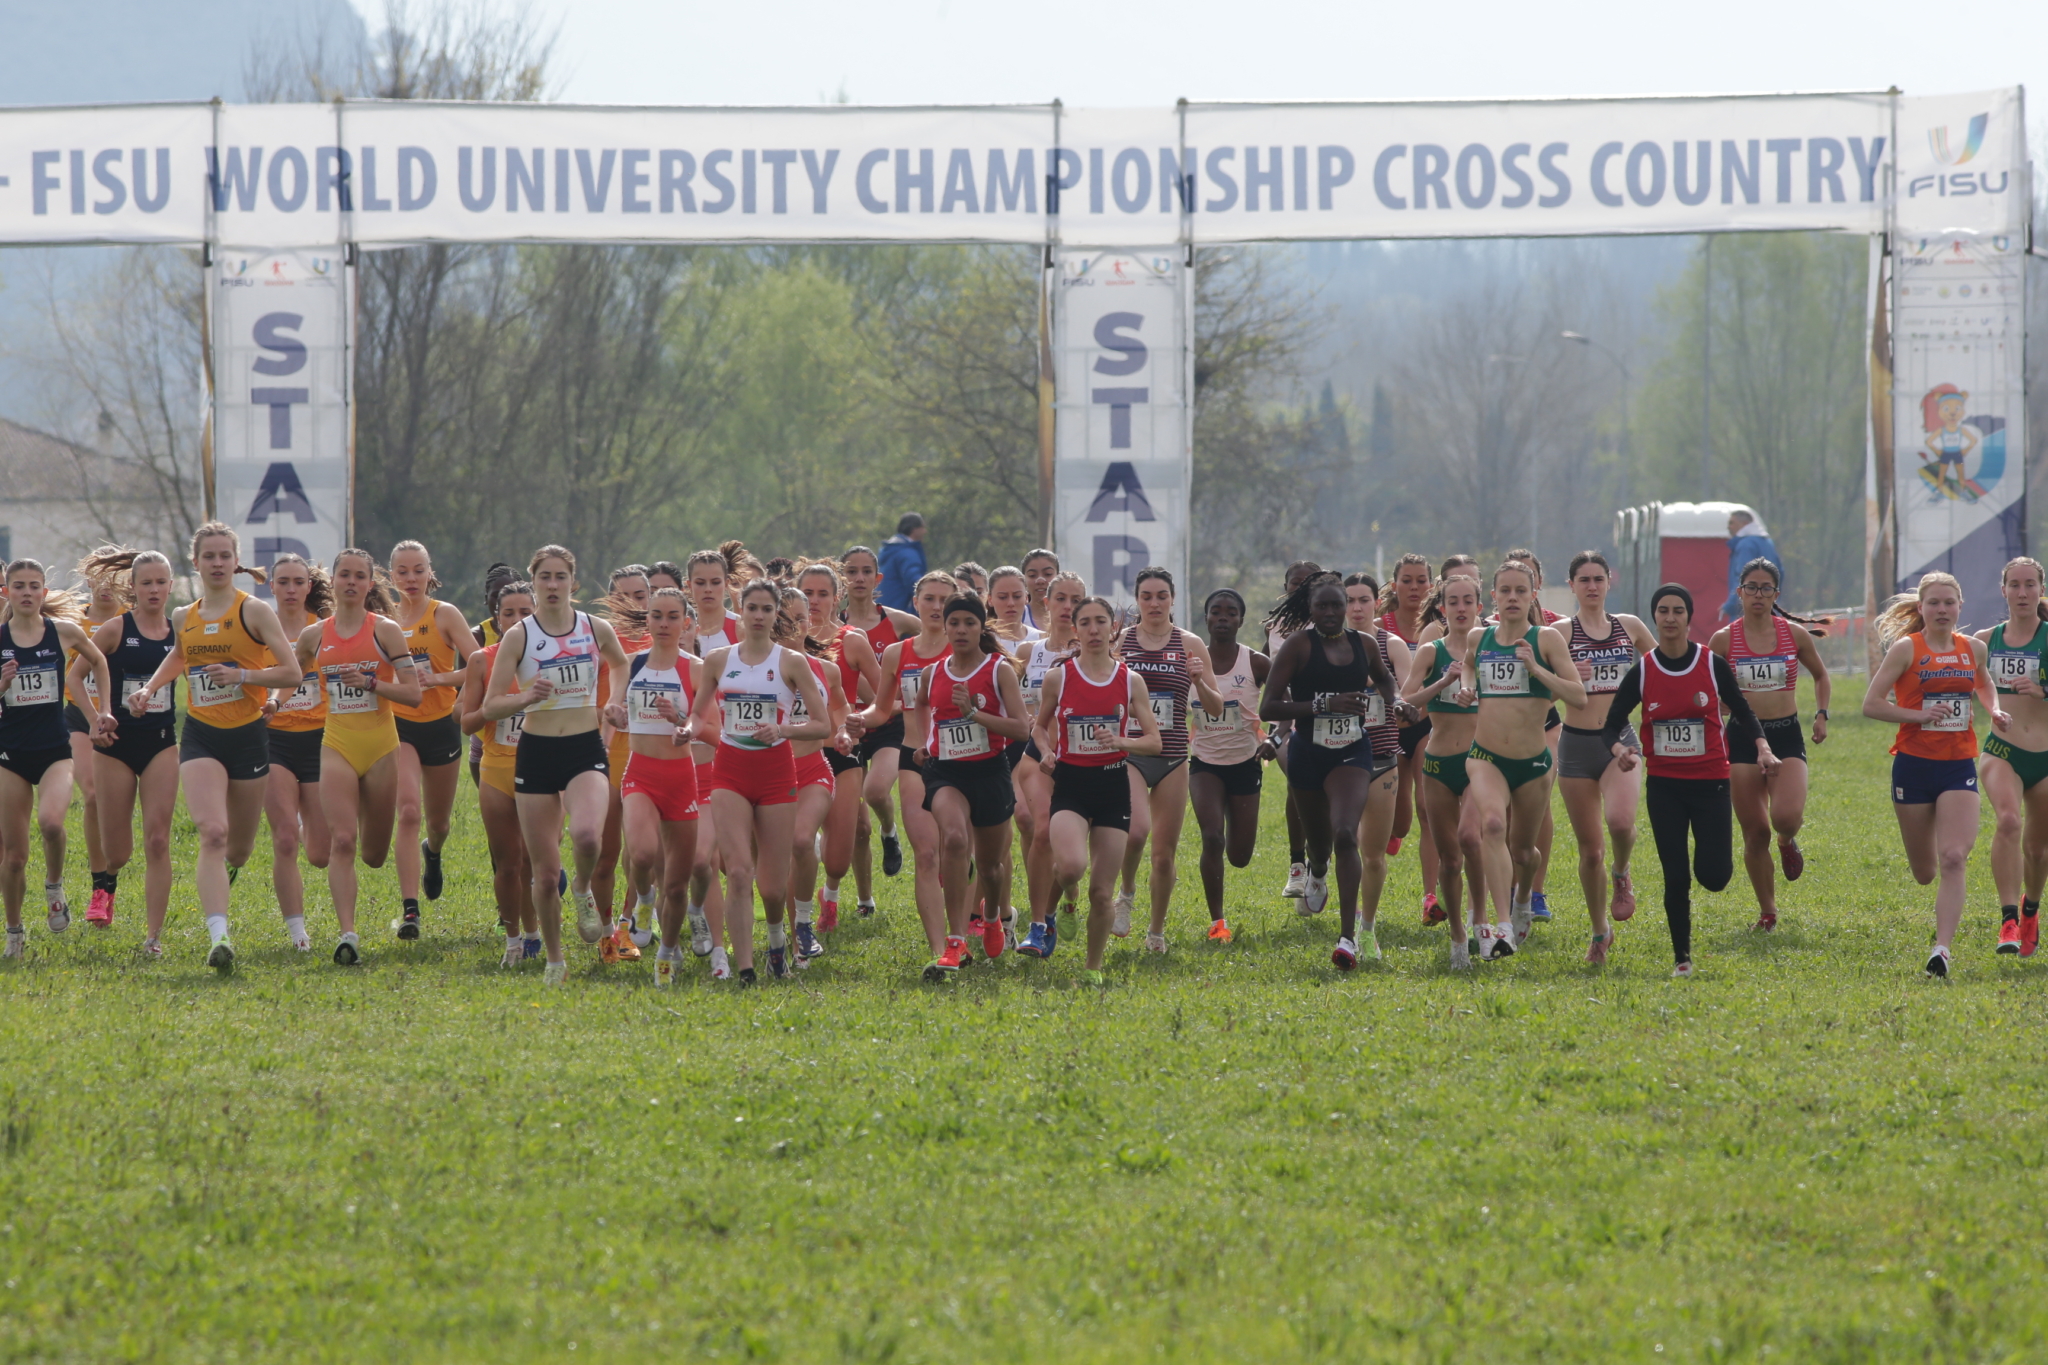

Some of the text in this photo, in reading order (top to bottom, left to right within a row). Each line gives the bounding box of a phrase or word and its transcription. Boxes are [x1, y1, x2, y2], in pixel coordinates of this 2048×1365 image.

[31, 147, 171, 215] FISU
[204, 145, 438, 213] WORLD
[457, 145, 840, 214] UNIVERSITY
[855, 145, 1355, 214] CHAMPIONSHIP
[1373, 141, 1572, 210] CROSS
[1590, 136, 1887, 208] COUNTRY
[1908, 170, 2009, 198] FISU
[187, 645, 232, 655] GERMANY
[1577, 647, 1628, 659] CANADA
[558, 664, 579, 684] 111
[1126, 663, 1176, 673] CANADA
[1491, 663, 1515, 680] 159
[1594, 664, 1619, 681] 155
[1750, 664, 1771, 680] 141
[1919, 669, 1975, 679] Nederland
[2001, 658, 2026, 675] 158
[18, 673, 42, 691] 113
[22, 694, 49, 702] QIAODAN
[205, 693, 233, 702] QIAODAN
[736, 702, 763, 720] 128
[949, 725, 973, 745] 101
[1328, 718, 1351, 735] 139
[1666, 725, 1692, 742] 103
[952, 746, 981, 756] QIAODAN
[1985, 739, 2011, 760] AUS
[1103, 763, 1121, 771] NIKE
